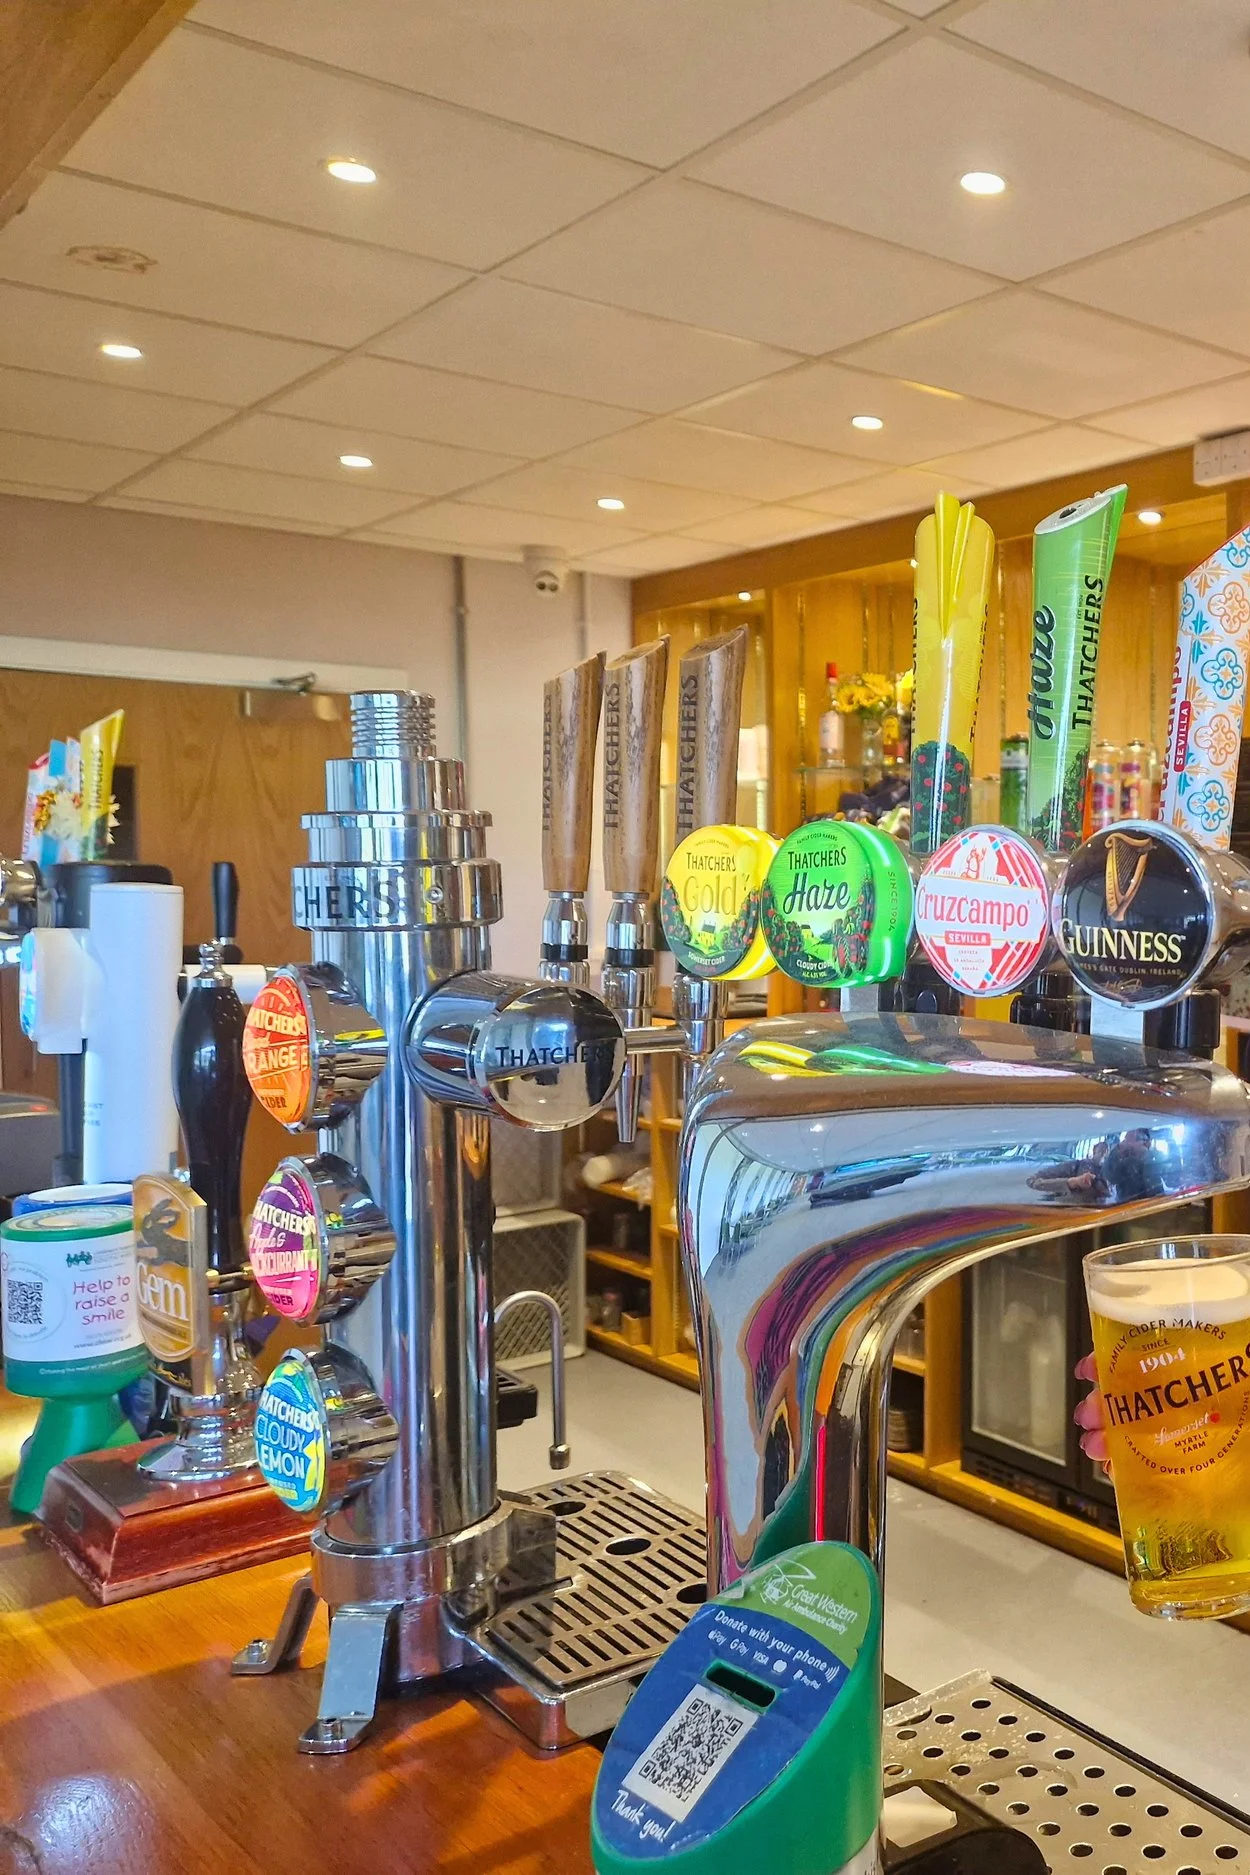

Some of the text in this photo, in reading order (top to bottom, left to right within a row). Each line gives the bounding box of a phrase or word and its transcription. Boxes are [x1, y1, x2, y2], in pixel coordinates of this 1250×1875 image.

[1027, 604, 1056, 741] Haze
[1072, 575, 1105, 730] THATCHERS
[676, 675, 699, 833] THATCHERS
[1176, 707, 1189, 765] SEVILLA
[604, 682, 620, 833] THATCHERS
[686, 852, 737, 872] THATCHERS
[788, 846, 847, 870] THATCHERS
[683, 875, 737, 916] Gold
[783, 872, 851, 915] Haze
[887, 871, 899, 932] SINCE 1904
[917, 886, 1029, 932] Cruzcampo
[948, 933, 987, 946] SEVILLA
[1060, 917, 1182, 964] GUINNESS
[796, 959, 817, 970] CLOUDY
[248, 1044, 298, 1075] RANGE
[73, 1274, 131, 1295] Help to
[75, 1292, 130, 1311] raise a
[137, 1260, 190, 1322] Gem
[267, 1296, 294, 1307] IDER
[82, 1309, 125, 1326] smile
[1109, 1318, 1227, 1374] FAMILY CIDER MAKERS
[1139, 1347, 1186, 1374] 1904
[1141, 1338, 1170, 1352] SINCE
[255, 1414, 306, 1453] CLOUDY
[1154, 1411, 1211, 1446] Somerset
[1174, 1431, 1209, 1449] MYRTLE
[1217, 1390, 1250, 1459] GENERATIONS
[256, 1438, 305, 1479] LEMON
[1124, 1435, 1216, 1475] CRAFTED OVER FOUR
[1182, 1440, 1207, 1455] FARM
[791, 1584, 858, 1624] Great Western
[792, 1602, 827, 1624] Ambulance
[826, 1618, 848, 1635] Charity
[713, 1631, 727, 1646] Pay
[753, 1650, 769, 1665] VISA
[714, 1610, 828, 1671] Donate with your phone
[610, 1788, 677, 1844] Thank you!
